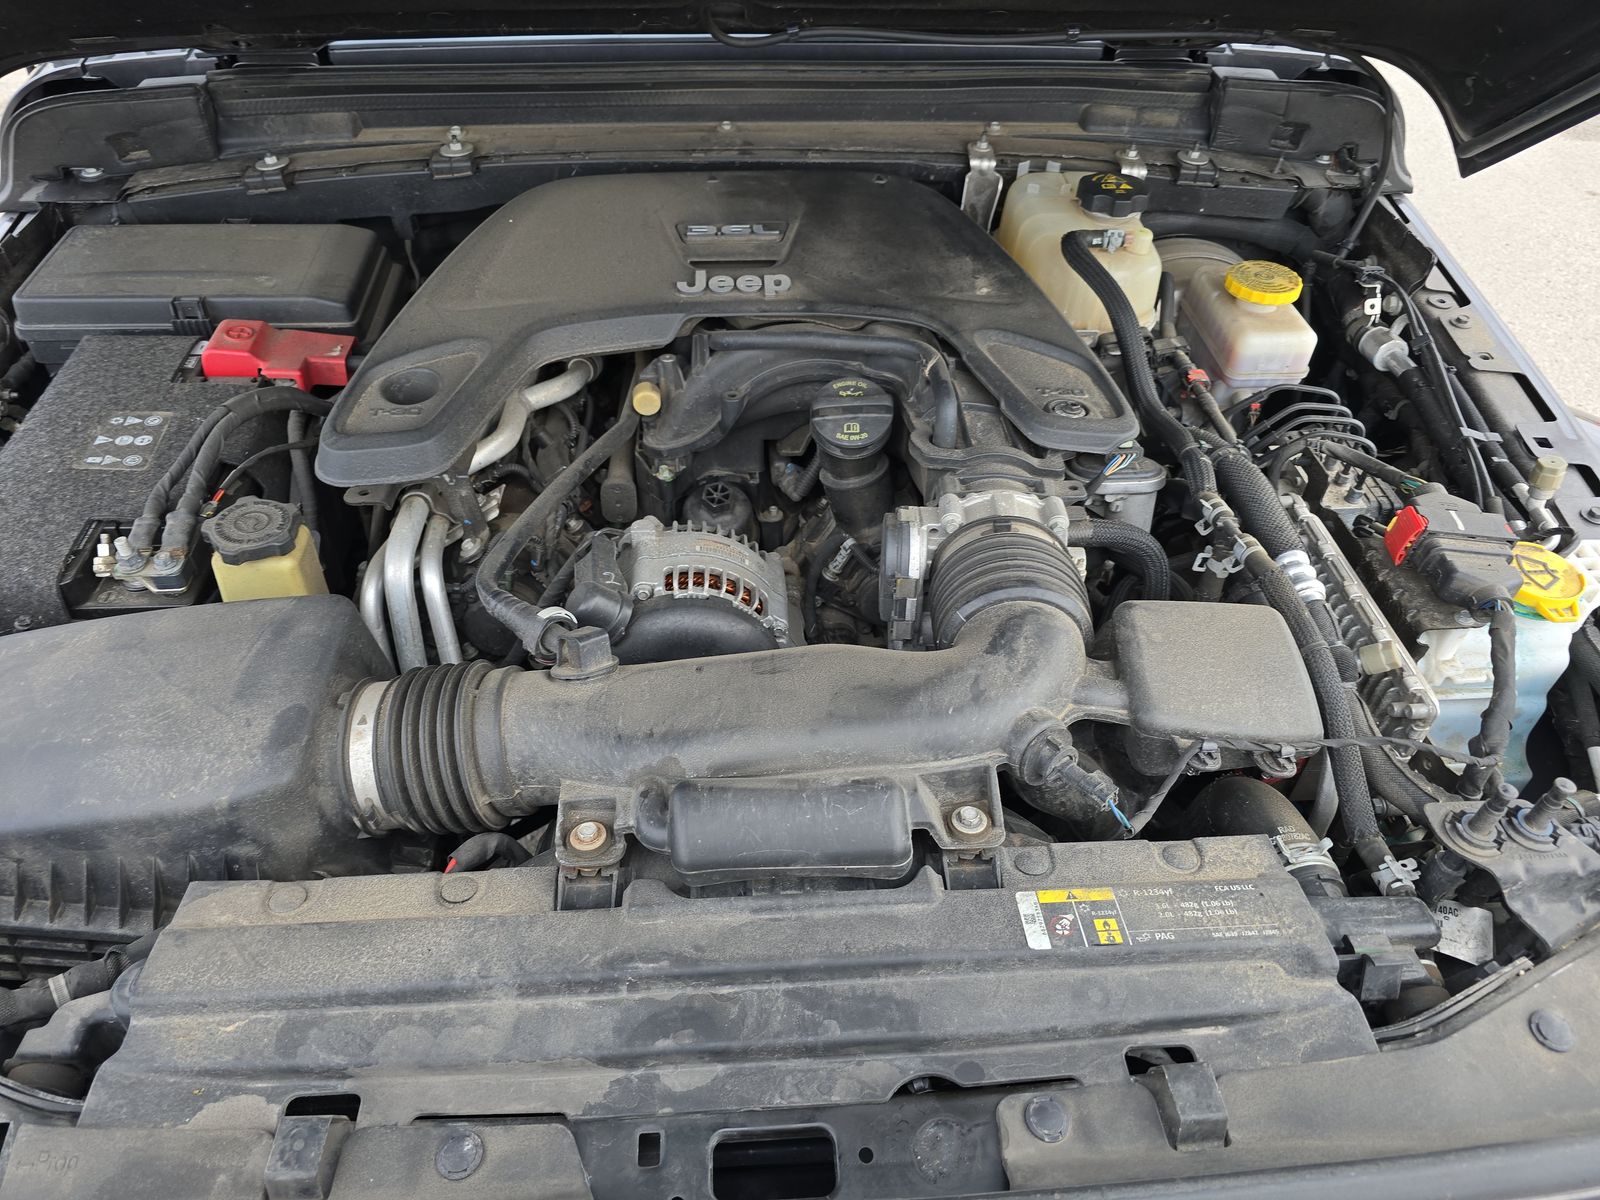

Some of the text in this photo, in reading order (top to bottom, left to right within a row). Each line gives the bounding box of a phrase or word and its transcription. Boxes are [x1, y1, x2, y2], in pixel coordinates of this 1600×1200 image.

[686, 224, 780, 236] 3.6L
[676, 269, 792, 297] Jeep
[832, 380, 868, 390] ENGINE OIL
[836, 432, 869, 441] SAE 0W-20
[1277, 825, 1296, 834] RAD
[1133, 887, 1174, 898] R-1234yf
[1154, 932, 1176, 940] PAG
